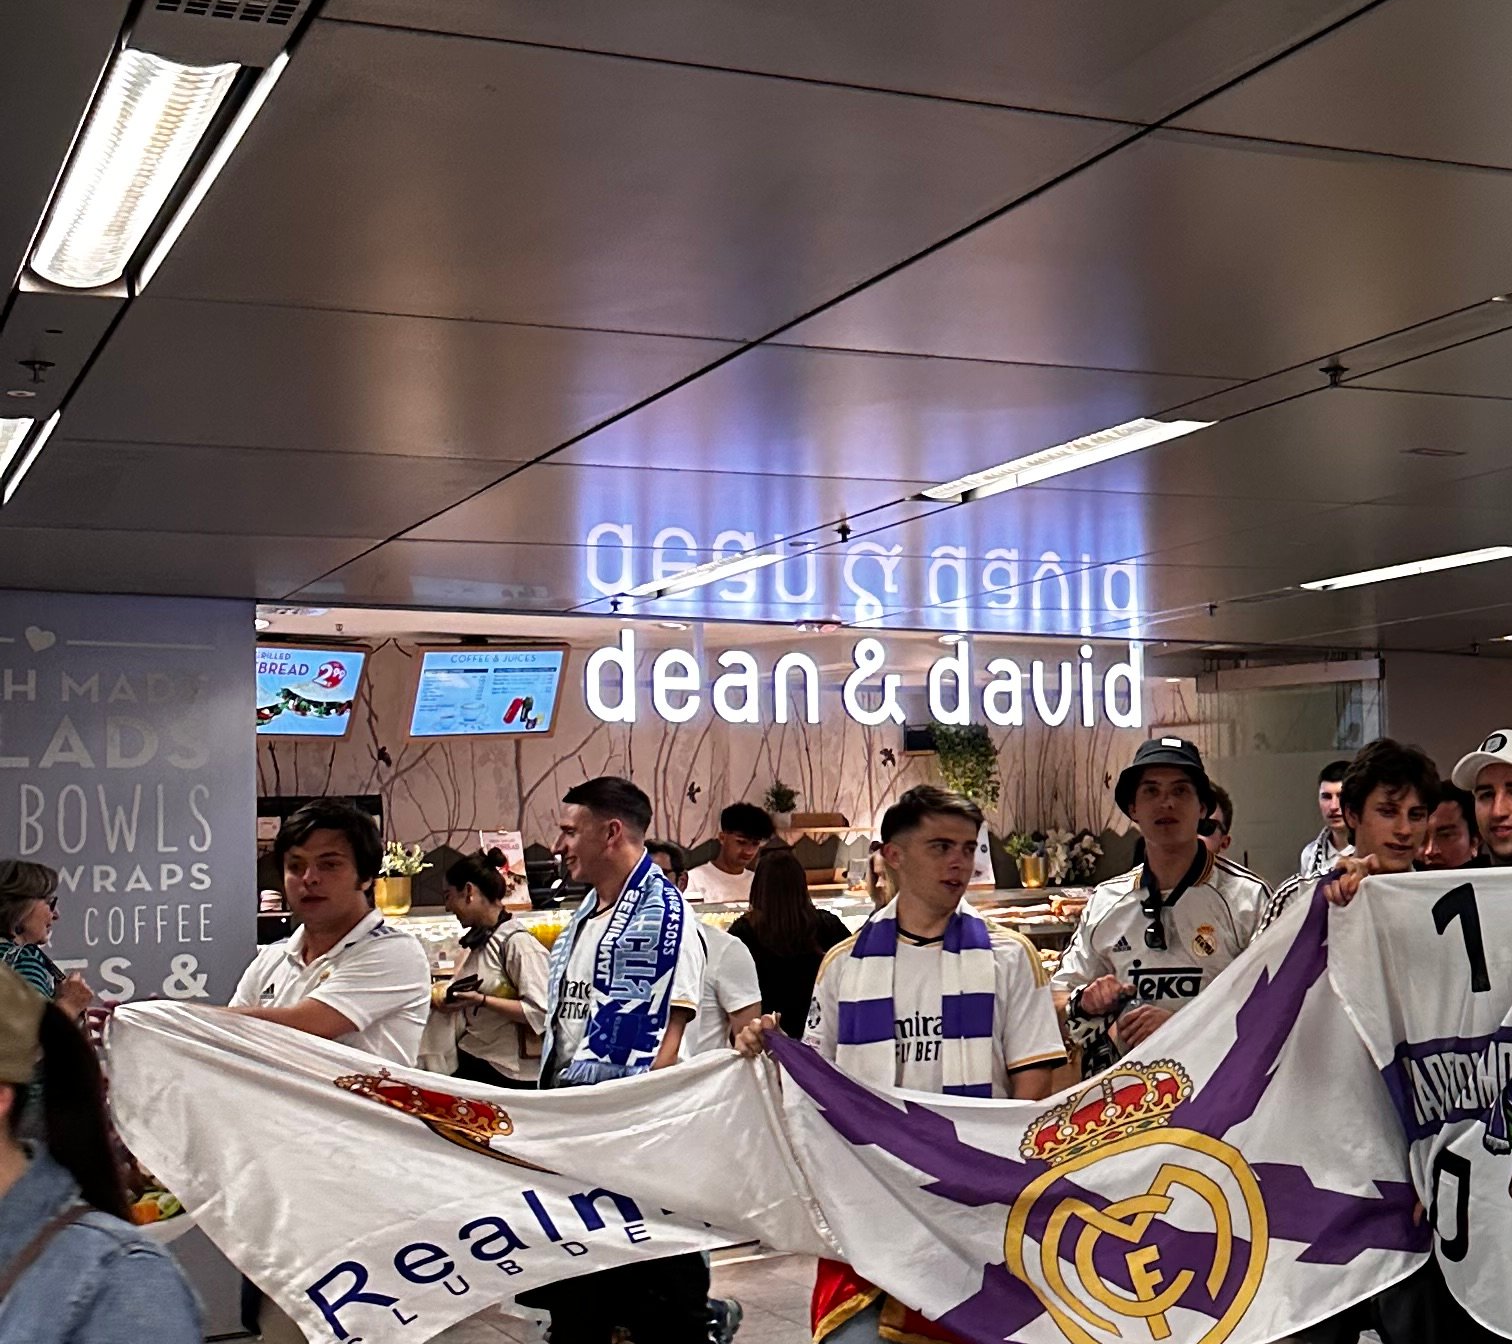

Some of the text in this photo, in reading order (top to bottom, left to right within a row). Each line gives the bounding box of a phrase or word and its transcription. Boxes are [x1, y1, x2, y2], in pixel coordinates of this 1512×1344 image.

[256, 651, 291, 660] RILLED
[257, 661, 309, 676] BREAD
[451, 654, 489, 664] COFFEE
[585, 628, 1142, 728] dean & david
[20, 783, 213, 855] BOWLS
[58, 862, 213, 893] WRAPS
[84, 903, 213, 946] COFFEE
[162, 953, 210, 1000] &
[914, 1040, 942, 1063] BET
